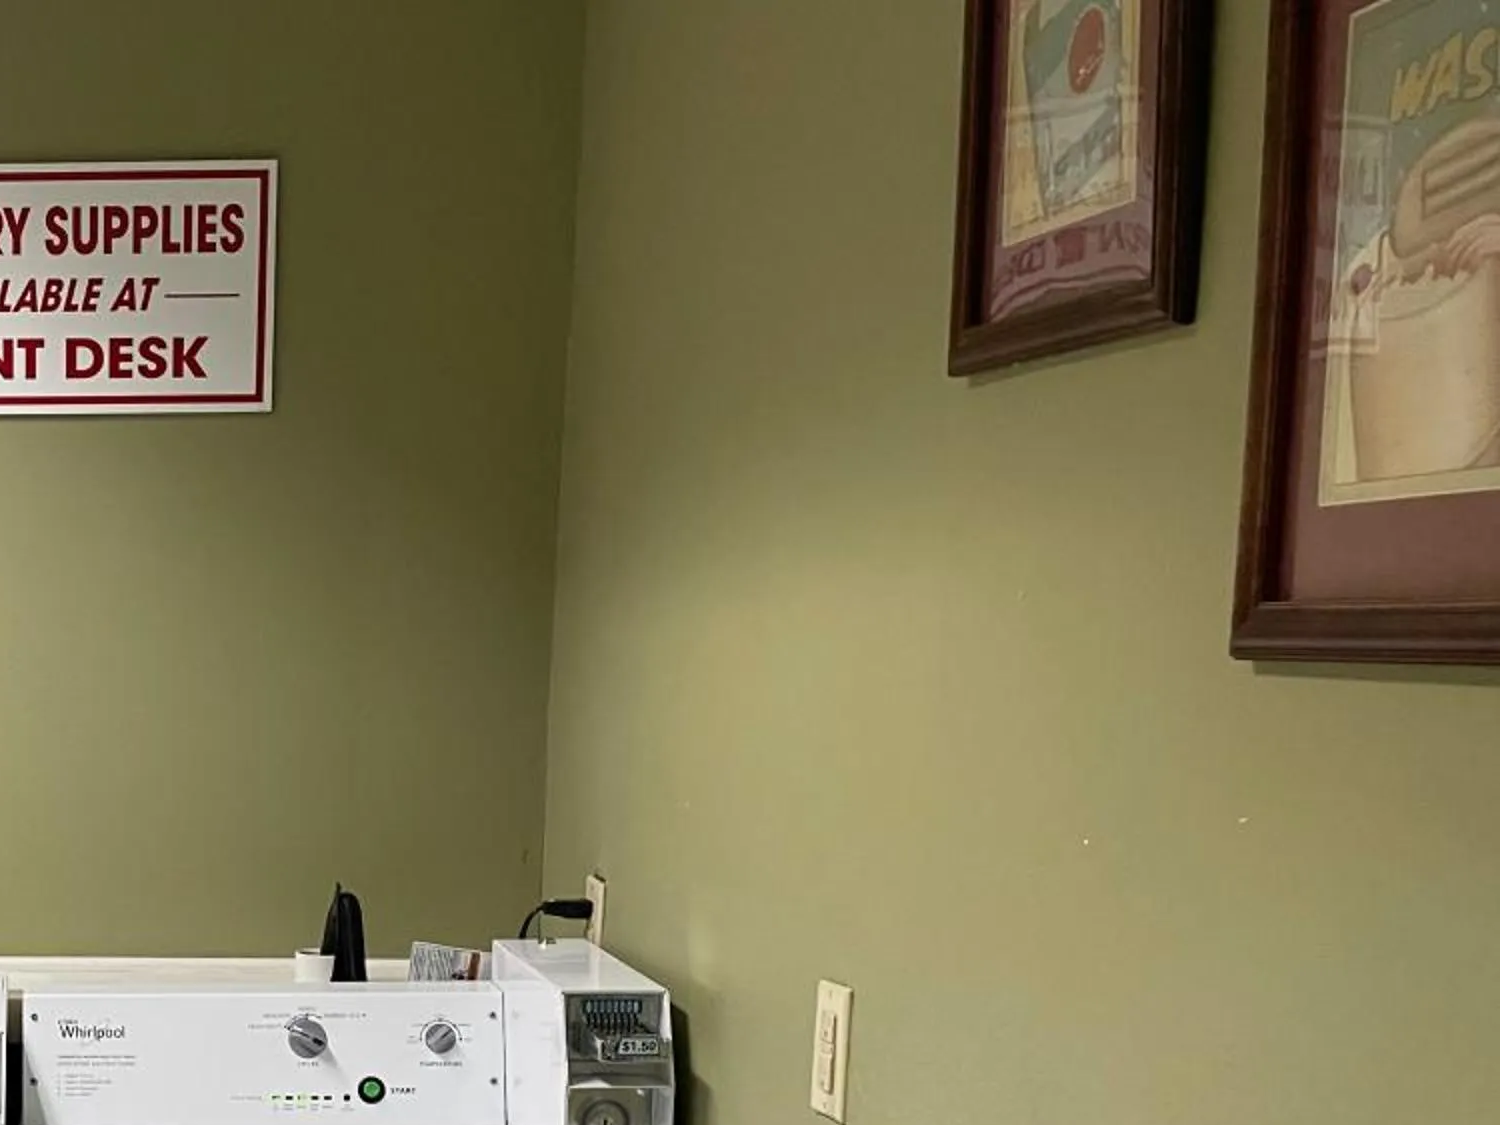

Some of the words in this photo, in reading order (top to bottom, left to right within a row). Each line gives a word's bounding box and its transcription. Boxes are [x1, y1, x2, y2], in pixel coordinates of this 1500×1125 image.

[1390, 28, 1500, 122] WAS
[45, 204, 245, 255] SUPPLIES
[111, 277, 160, 312] AT
[64, 336, 208, 379] DESK
[60, 1025, 125, 1041] Whirlpool
